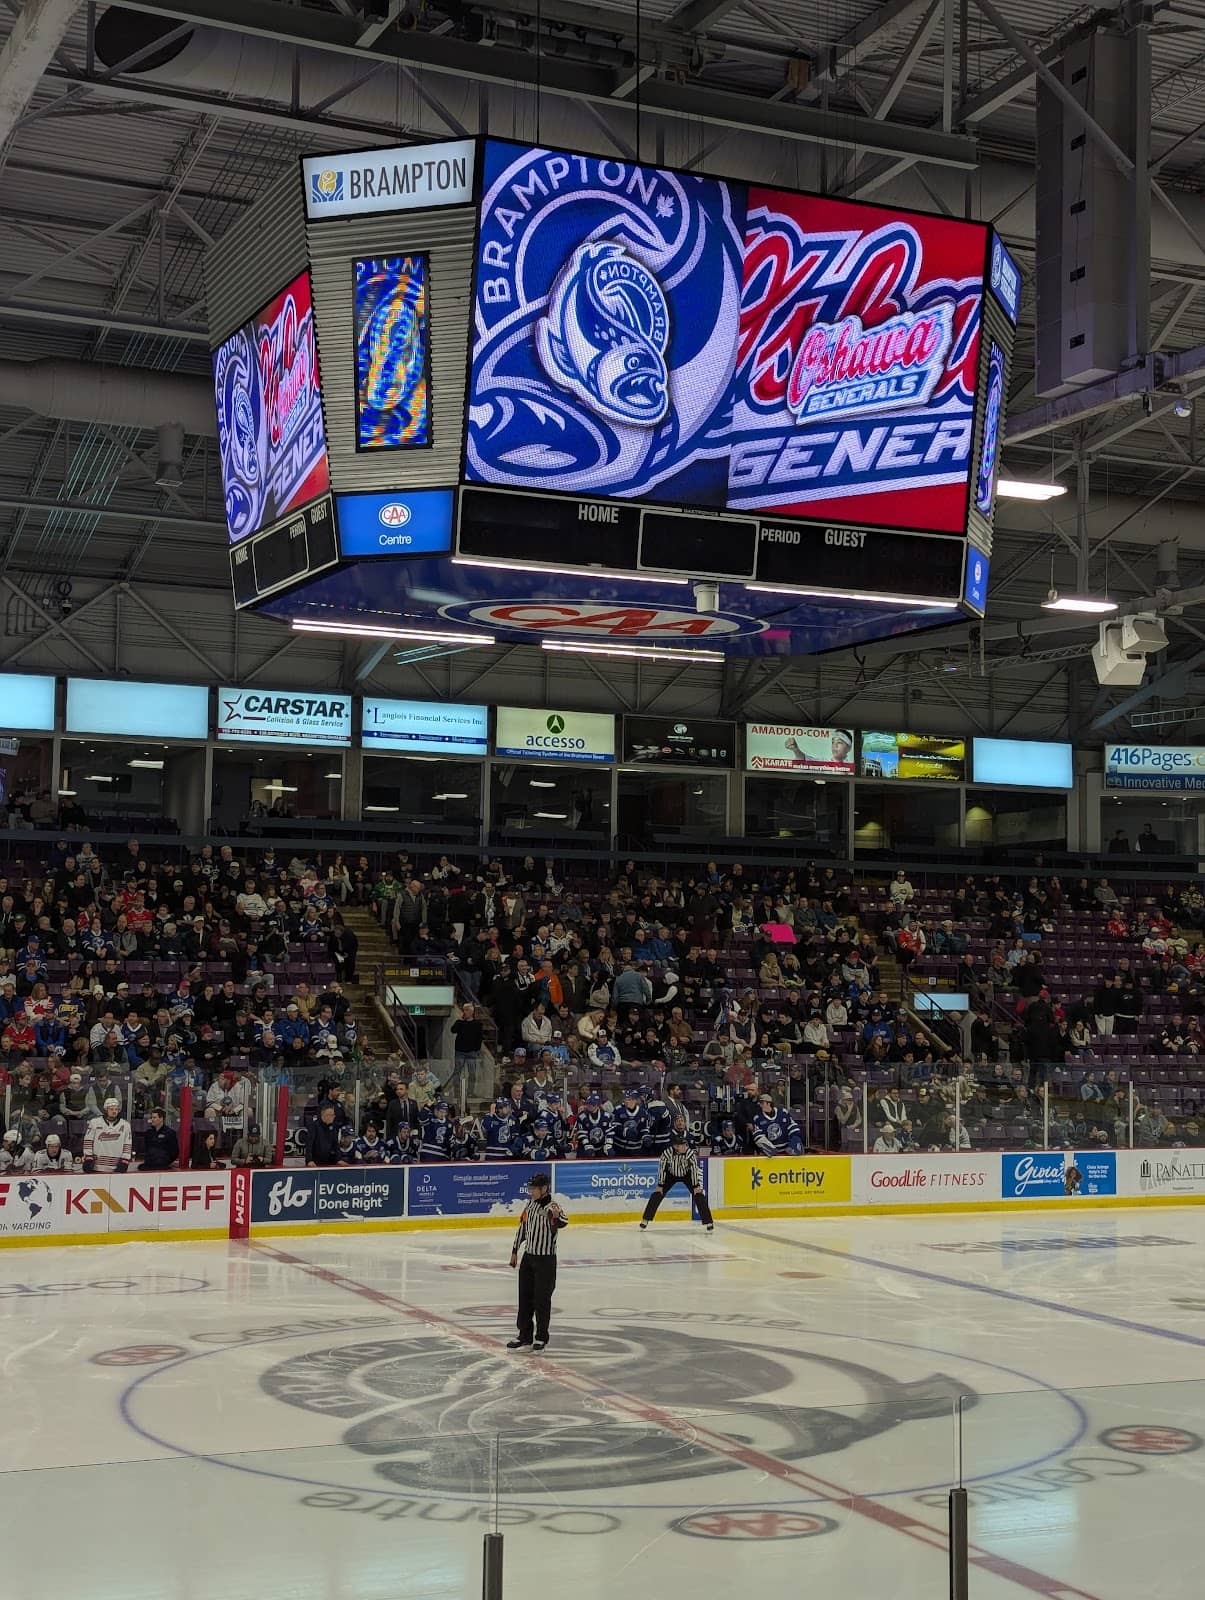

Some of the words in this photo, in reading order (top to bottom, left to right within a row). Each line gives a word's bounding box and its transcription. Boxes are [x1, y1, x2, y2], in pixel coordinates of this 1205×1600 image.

[349, 157, 467, 199] BRAMPTON
[482, 154, 657, 304] BRAMPTON
[807, 373, 920, 413] GENERALS
[384, 508, 408, 524] CAA
[578, 503, 620, 524] HOME
[378, 533, 413, 546] Centre
[760, 528, 801, 545] PERIOD
[824, 528, 867, 548] GUEST
[489, 605, 715, 636] CAA
[244, 695, 345, 719] CARSTAR
[266, 715, 294, 725] Collision
[302, 719, 320, 727] Glass
[320, 720, 344, 728] Service
[408, 713, 441, 723] Financial
[442, 716, 471, 725] Services
[526, 735, 585, 750] accesso
[765, 759, 793, 768] KARATE
[1123, 776, 1181, 789] Innovative
[591, 1173, 656, 1188] SmartStop
[768, 1167, 825, 1187] entripy
[871, 1169, 927, 1188] GoodLife
[930, 1172, 985, 1186] FITNESS
[268, 1176, 312, 1216] flo
[319, 1184, 334, 1196] EV
[336, 1182, 390, 1196] Charging
[602, 1188, 616, 1196] Self
[617, 1188, 644, 1197] Storage
[65, 1184, 225, 1215] KANEFF
[236, 1174, 246, 1225] CCM
[318, 1199, 349, 1210] Done
[352, 1197, 383, 1211] Right
[190, 1316, 392, 1344] Centre
[301, 1490, 622, 1535] Centre
